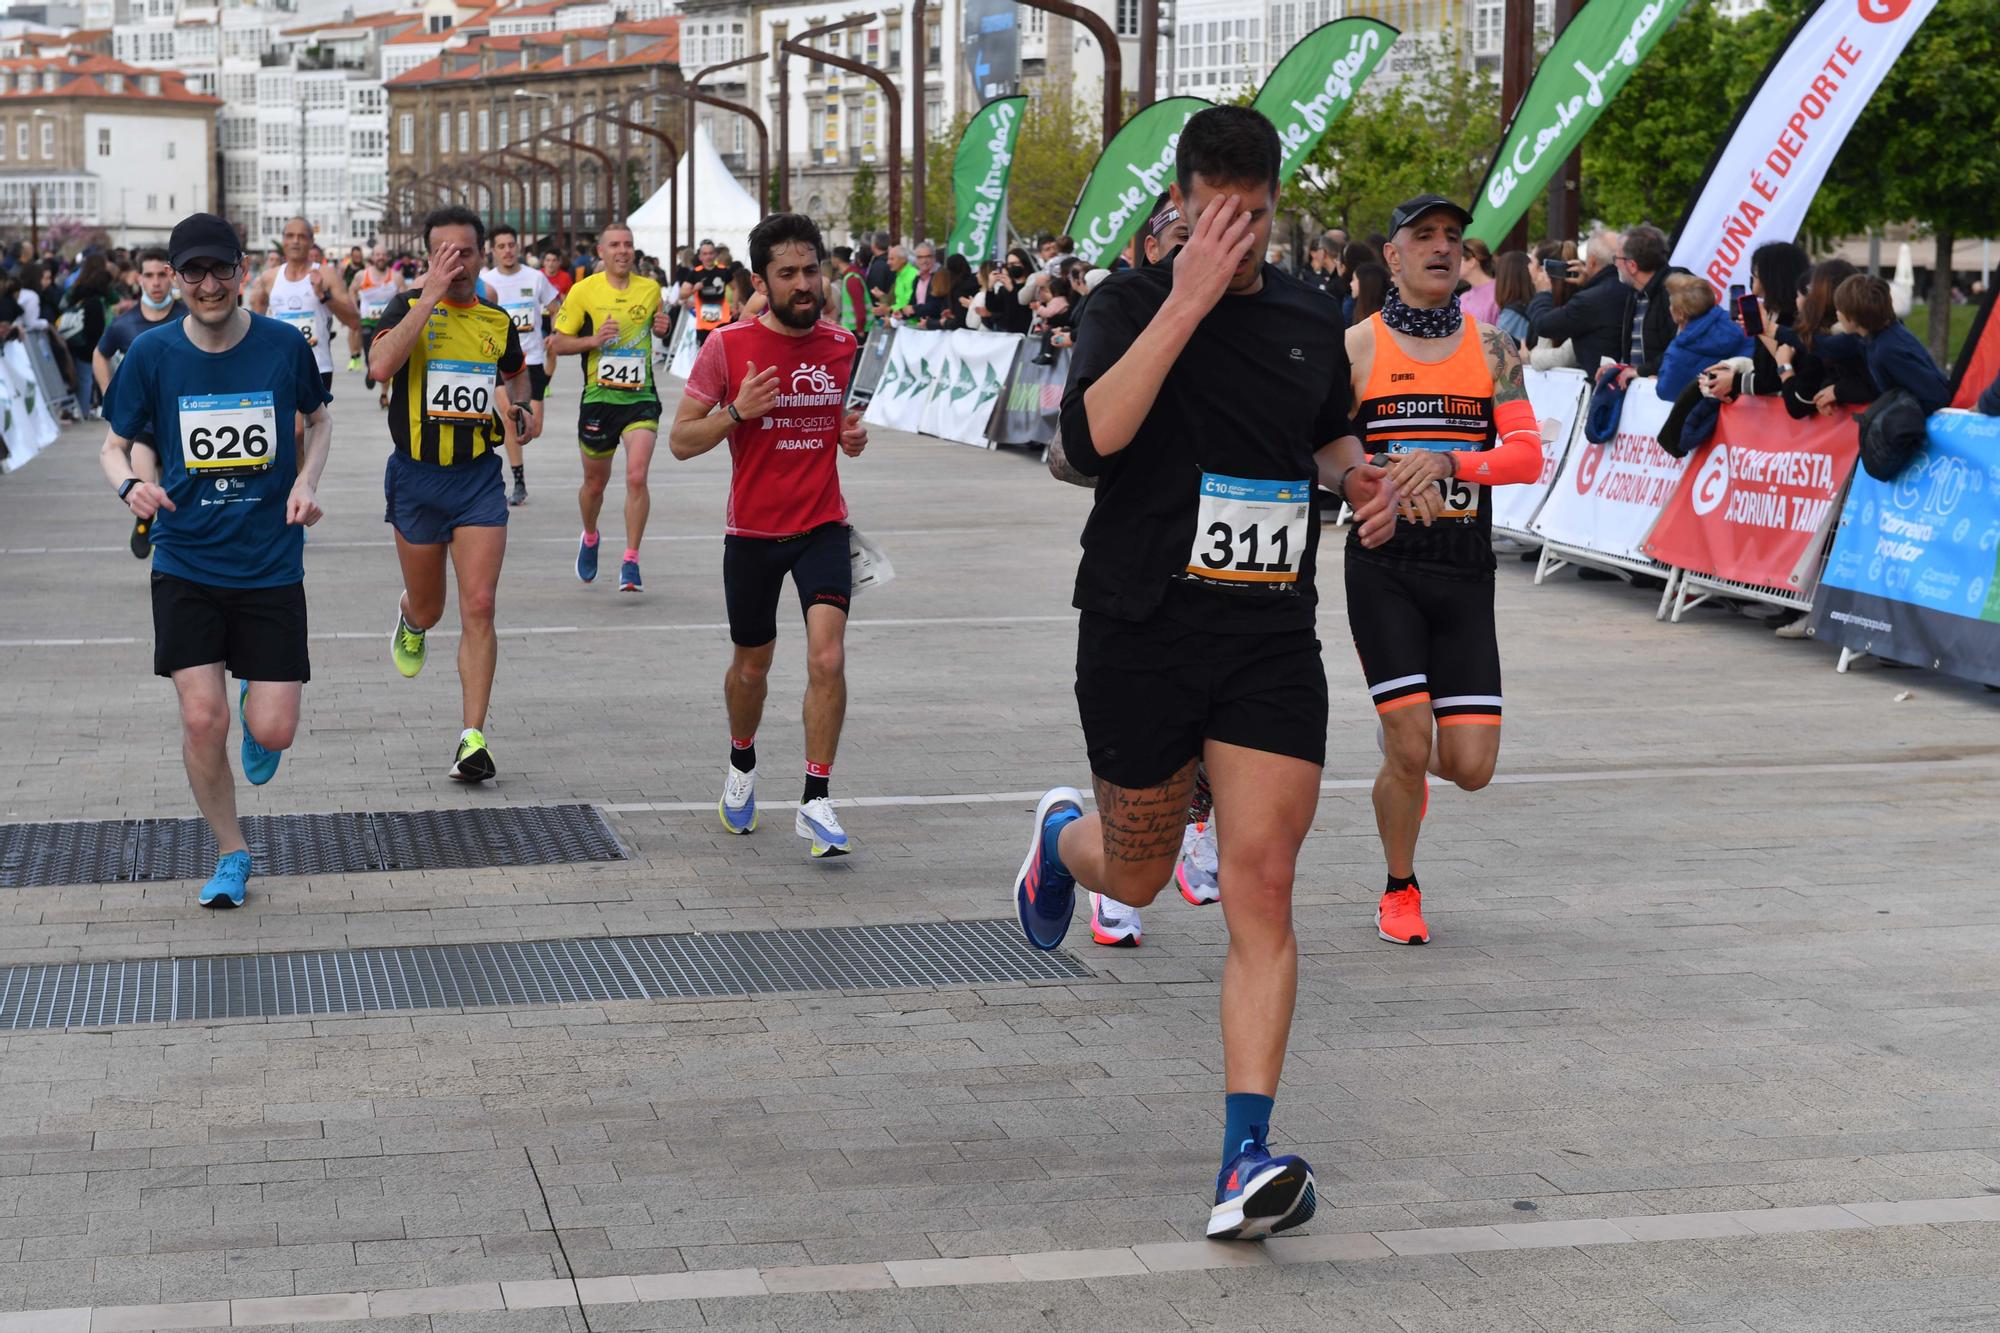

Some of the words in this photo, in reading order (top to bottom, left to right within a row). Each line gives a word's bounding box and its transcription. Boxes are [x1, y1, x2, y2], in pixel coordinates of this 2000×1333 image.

[1513, 95, 1584, 175] Corte
[1750, 168, 1779, 203] É
[1765, 36, 1863, 178] DEPORTE
[1089, 186, 1147, 245] Corte
[601, 364, 641, 383] 241
[432, 384, 488, 413] 460
[1377, 396, 1482, 417] nosportlimit
[189, 424, 269, 461] 626
[1765, 452, 1835, 495] PRESTA,
[1732, 485, 1787, 530] CORUÑA
[1200, 521, 1293, 572] 311
